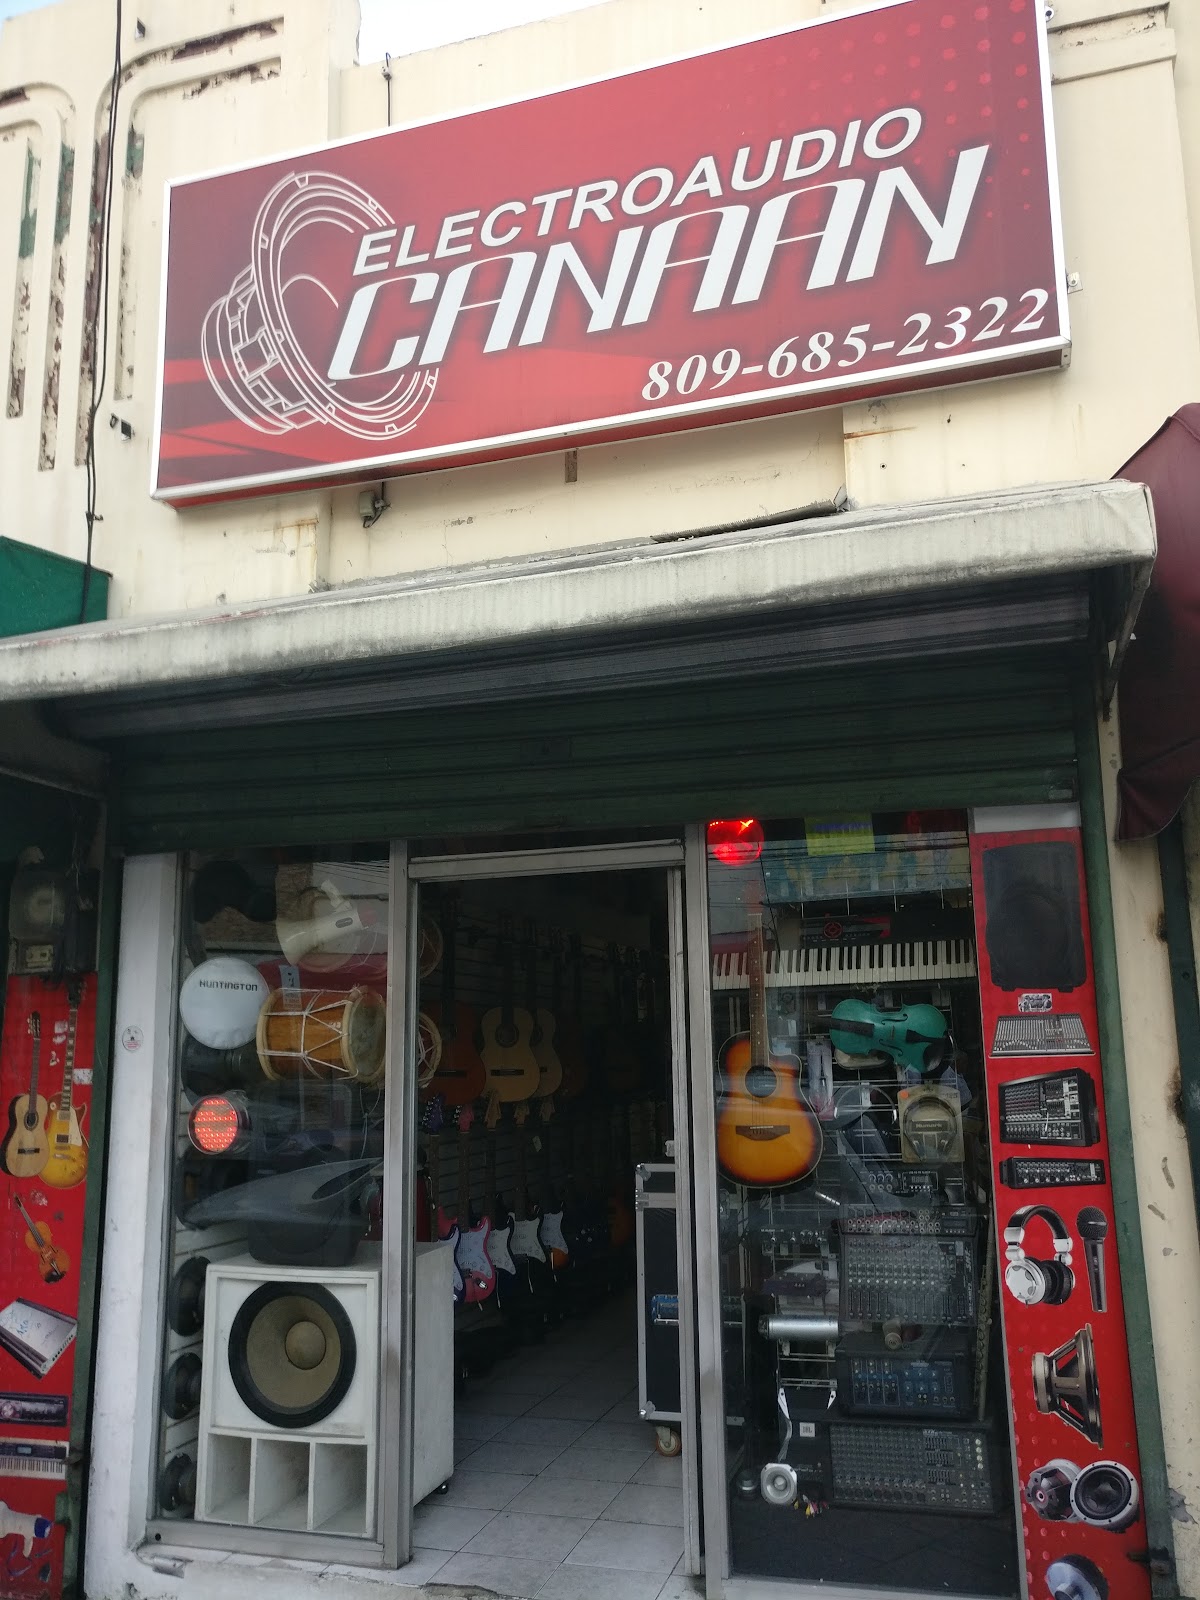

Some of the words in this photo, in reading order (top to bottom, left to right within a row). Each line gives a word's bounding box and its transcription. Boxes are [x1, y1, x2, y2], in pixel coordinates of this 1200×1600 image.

[327, 144, 991, 381] CANAAN
[352, 107, 923, 277] ELECTROAUDIO
[641, 288, 1049, 402] 809-685-2322
